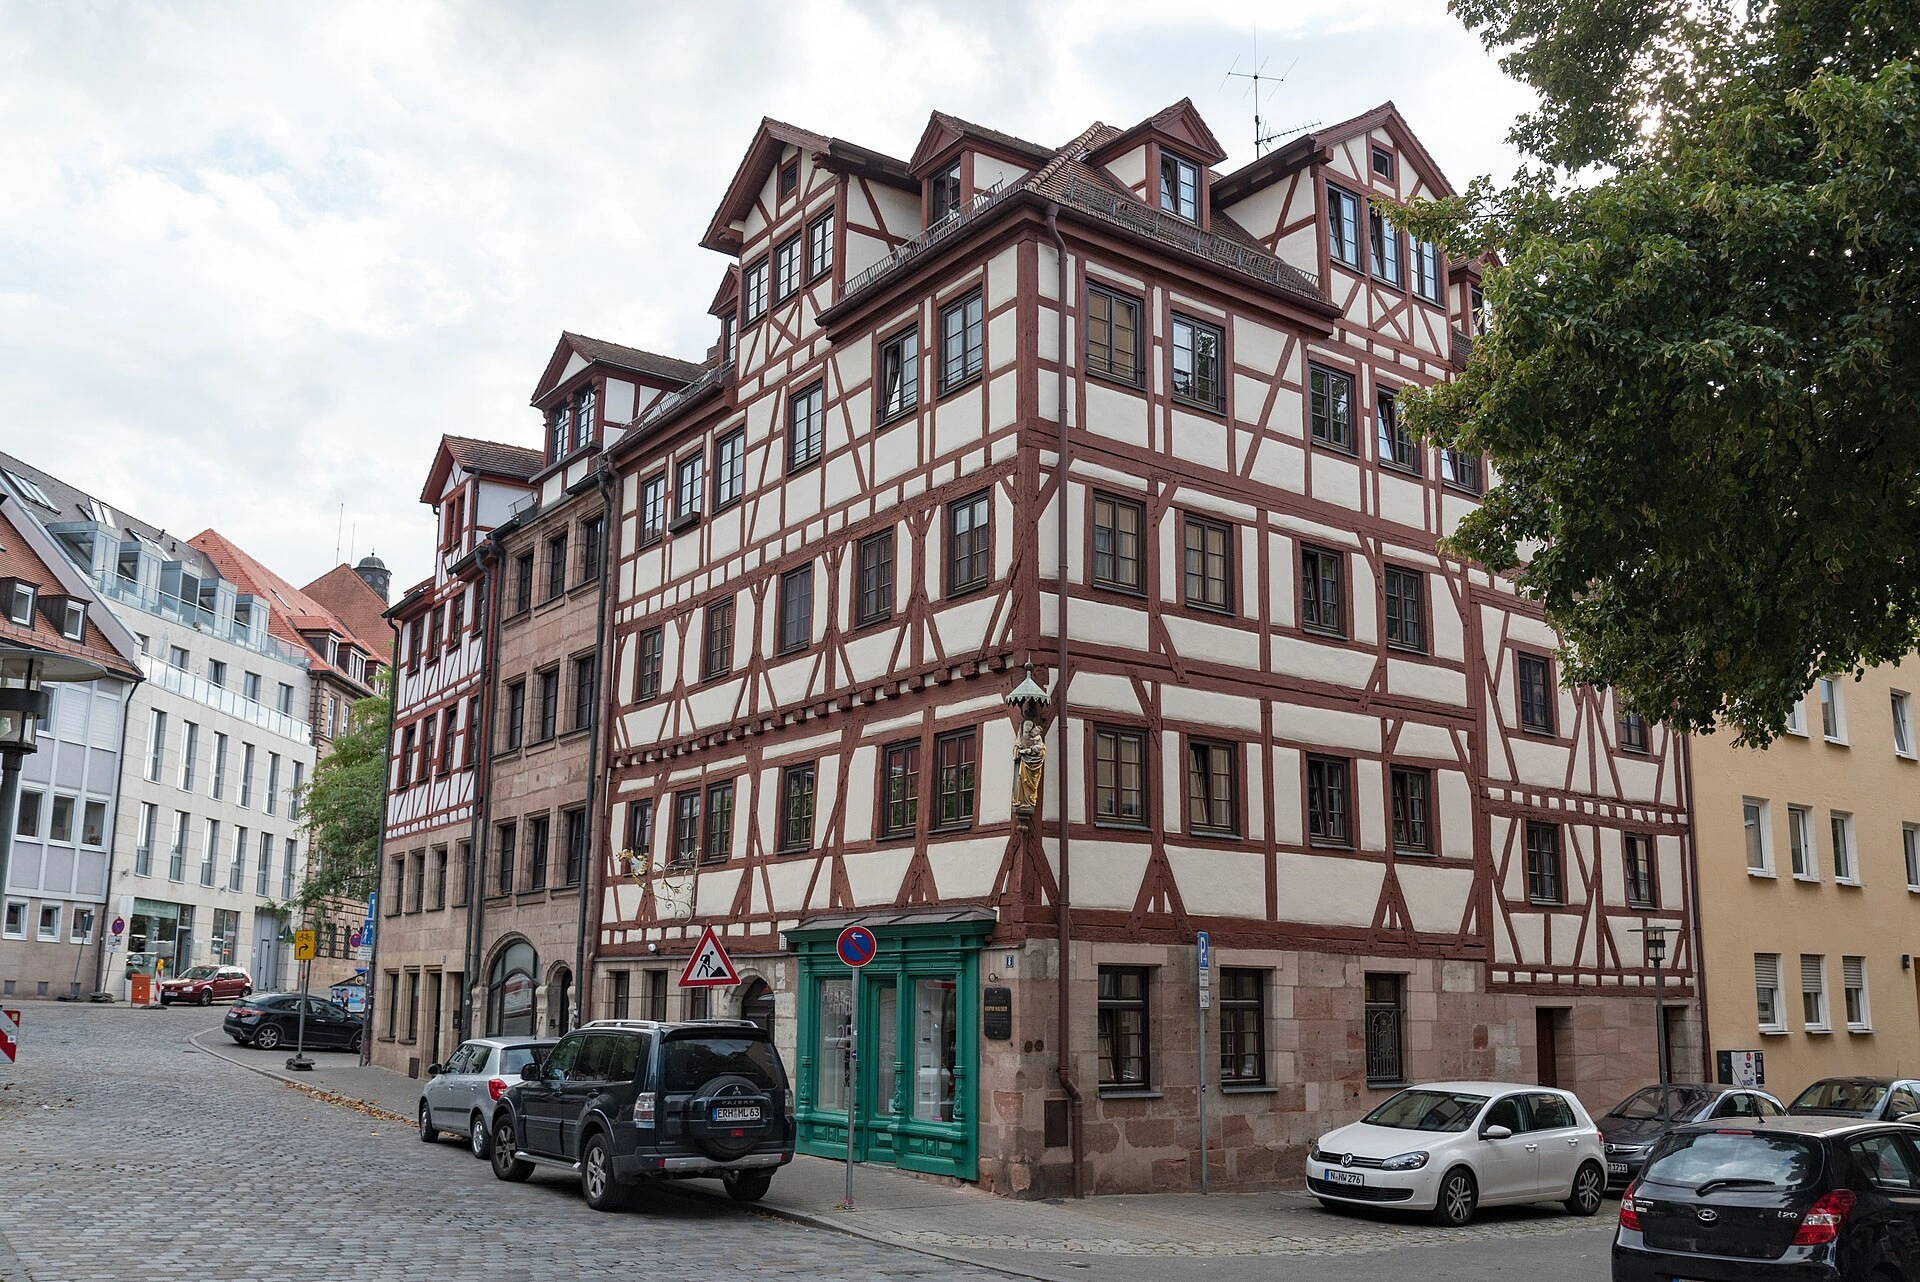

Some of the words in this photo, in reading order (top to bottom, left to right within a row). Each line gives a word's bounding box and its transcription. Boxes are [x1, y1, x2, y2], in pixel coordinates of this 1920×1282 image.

[1200, 936, 1206, 964] P
[749, 1107, 760, 1117] 63
[1347, 1174, 1361, 1184] 276
